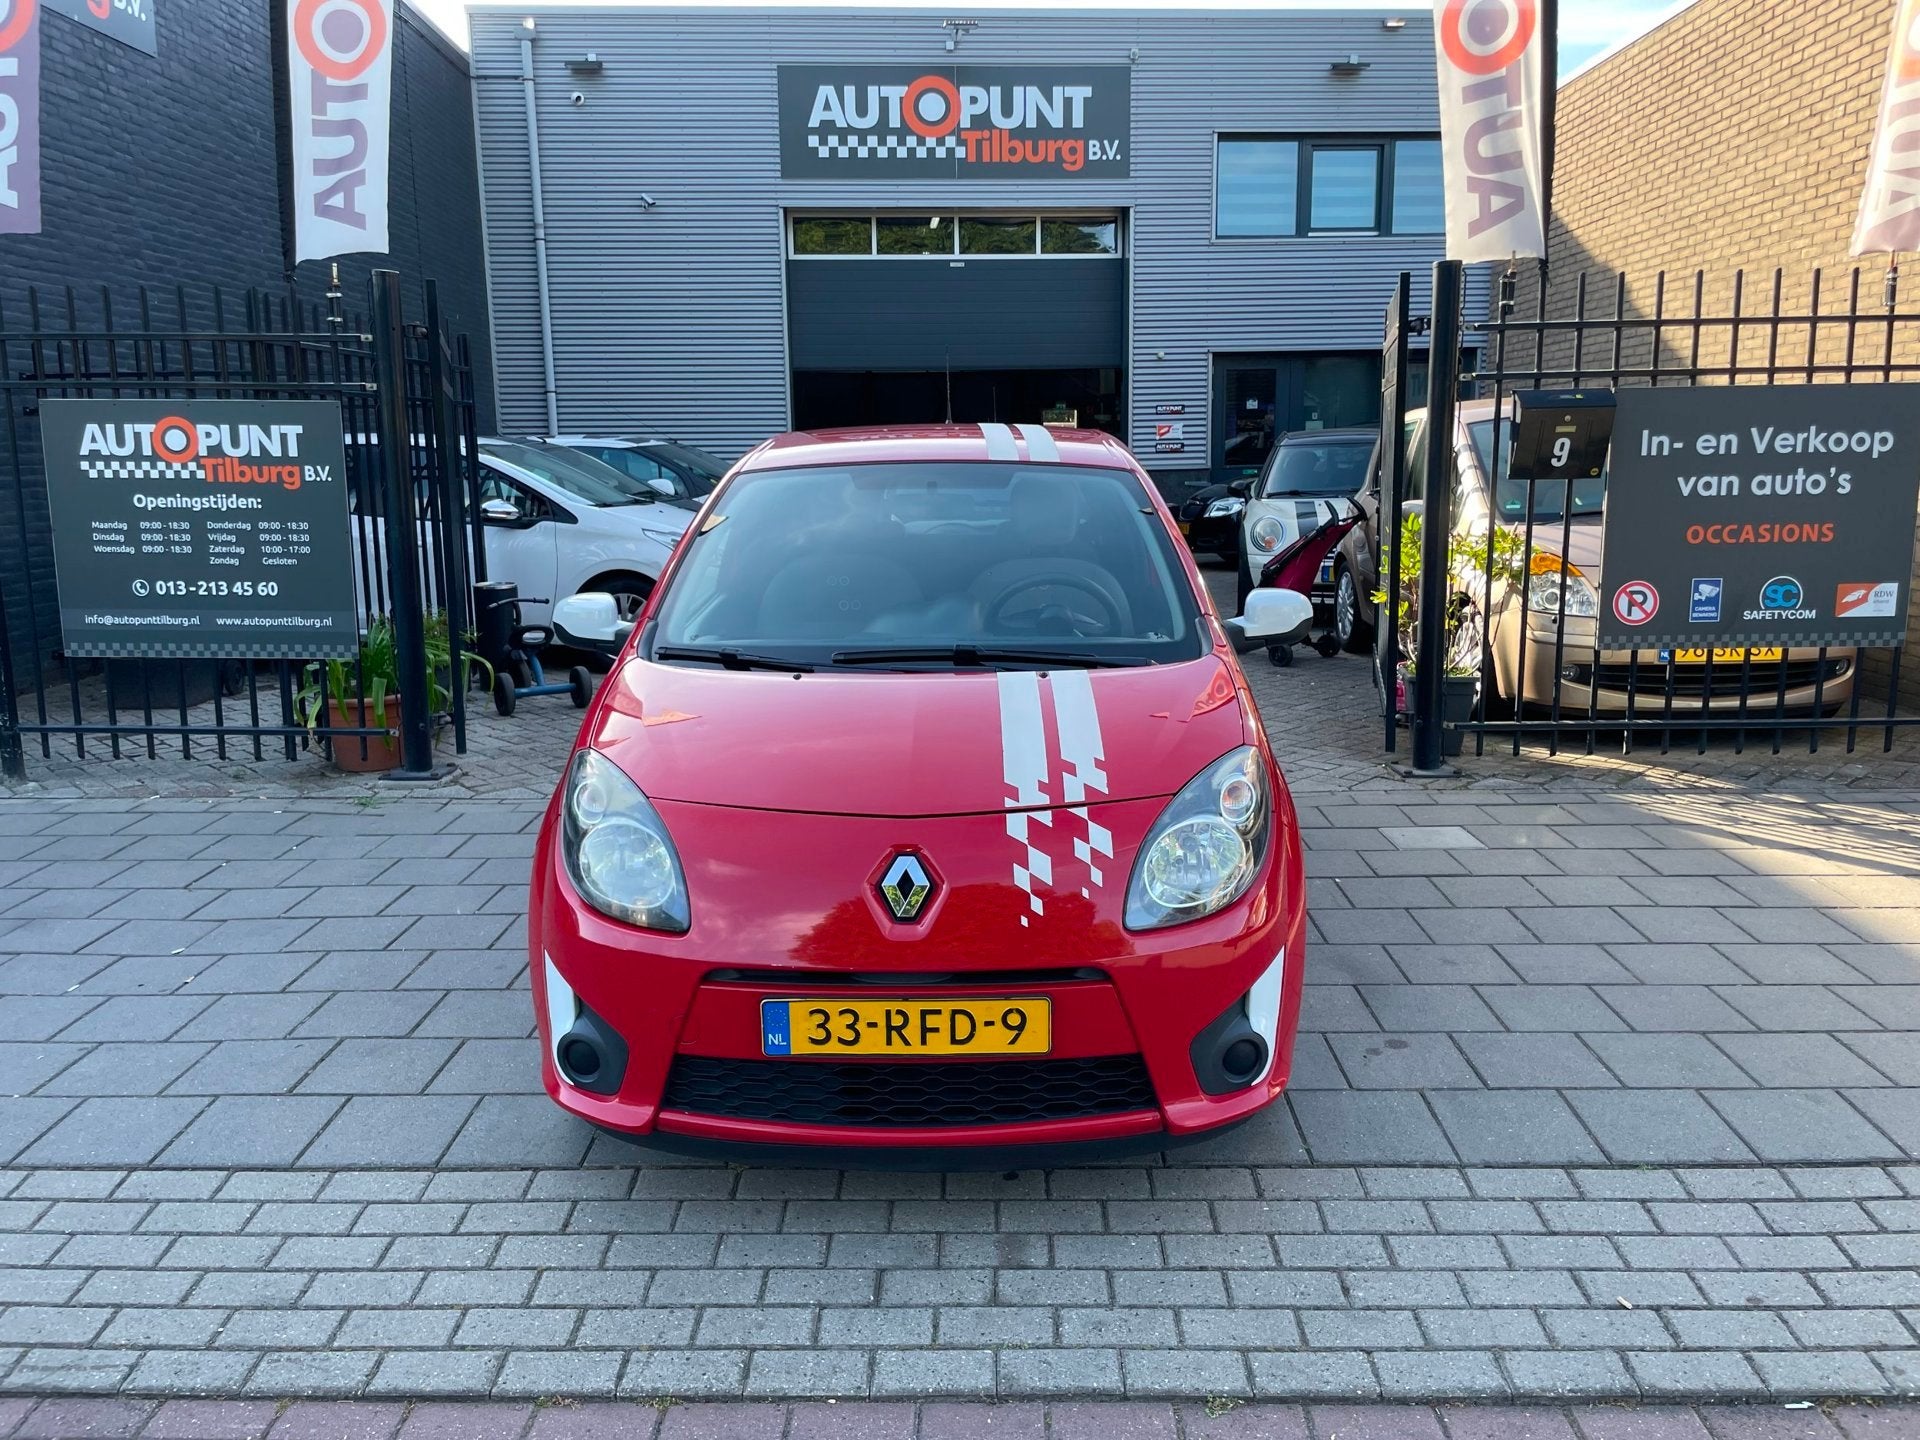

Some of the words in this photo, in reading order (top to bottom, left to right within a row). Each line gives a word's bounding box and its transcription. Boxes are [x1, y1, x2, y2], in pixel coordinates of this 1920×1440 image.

[808, 75, 1093, 138] AUTOPUNT
[960, 129, 1085, 172] Tilburg
[1088, 140, 1122, 161] B.V.
[79, 416, 303, 463] AUTOPUNT
[1640, 429, 1684, 457] In-
[1695, 433, 1738, 455] en
[1750, 425, 1894, 459] Verkoop
[1551, 437, 1571, 467] 9
[200, 457, 301, 490] Tilburg
[304, 466, 332, 482] B.V.
[1677, 474, 1740, 497] van
[1750, 466, 1852, 497] auto's
[132, 494, 262, 511] Openingstijden:
[91, 521, 128, 530] Maandag
[140, 522, 162, 530] 09:00
[168, 522, 190, 530] 18:30
[207, 521, 252, 531] Donderdag
[258, 521, 281, 530] 09:00
[287, 522, 309, 530] 18:30
[93, 533, 125, 542] Dinsdag
[141, 533, 163, 541] 09:00
[208, 533, 237, 542] Vrijdag
[259, 533, 282, 542] 09:00
[288, 534, 310, 542] 18:30
[1685, 522, 1835, 545] OCCASIONS
[94, 545, 135, 554] Woensdag
[142, 545, 164, 553] 09:00
[209, 545, 245, 554] Zaterdag
[261, 546, 283, 554] 10:00
[289, 546, 311, 554] 17:00
[209, 557, 240, 566] Zondag
[262, 557, 298, 565] Gesloten
[232, 581, 253, 596] 45
[257, 581, 279, 596] 60
[1874, 590, 1894, 598] RDW
[84, 614, 200, 627] info@autopunttilburg.nl
[1743, 610, 1816, 620] SAFETYCOM
[216, 616, 333, 628] www.autopunttilburg.nl
[807, 1007, 1028, 1046] 33-RFD-9
[768, 1033, 787, 1045] NL
